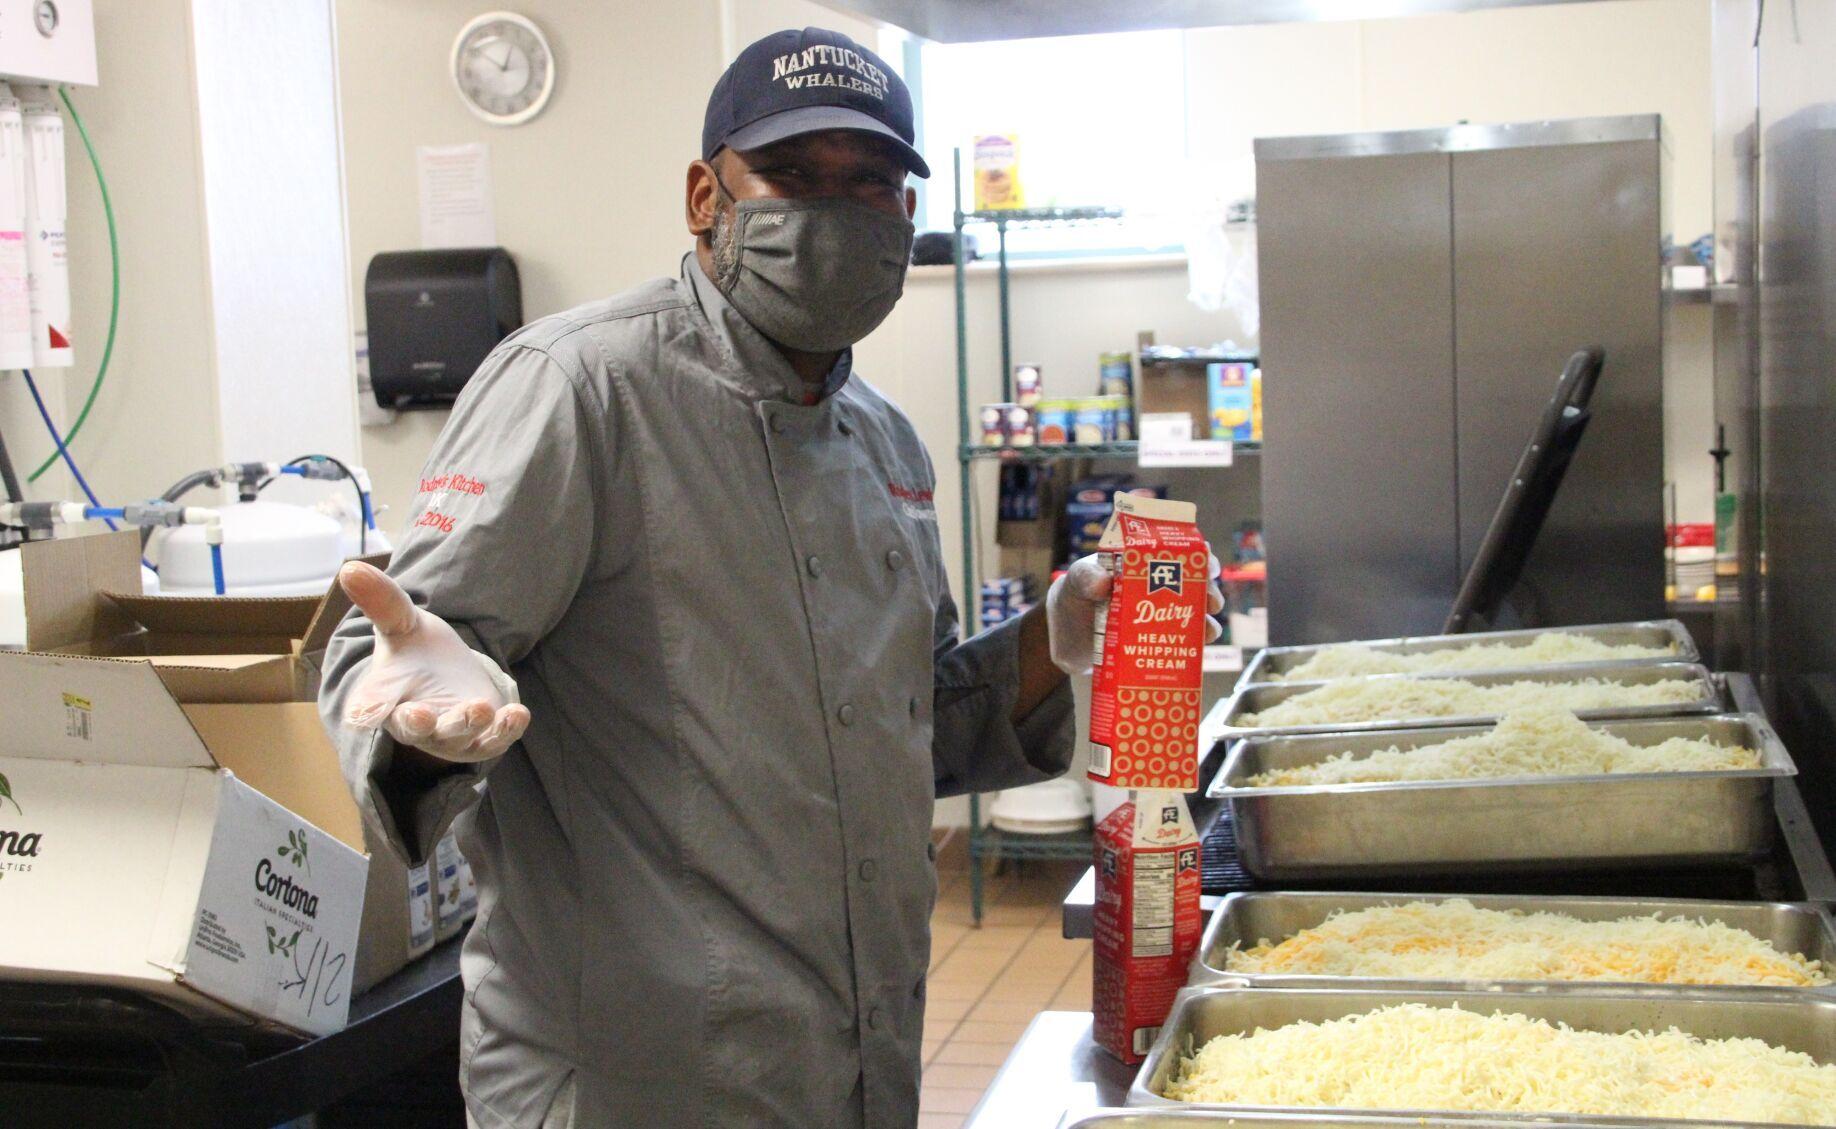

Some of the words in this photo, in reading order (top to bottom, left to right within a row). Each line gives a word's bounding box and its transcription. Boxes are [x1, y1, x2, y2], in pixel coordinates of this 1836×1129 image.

[772, 44, 889, 93] NANTUCKET
[785, 72, 884, 100] WHALERS
[448, 474, 486, 496] Kitchen
[420, 511, 457, 533] 2016
[1125, 535, 1158, 549] Dairy
[1133, 600, 1195, 628] Dairy
[1137, 633, 1187, 645] HEAVY
[1123, 645, 1198, 657] WHIPPING
[1135, 658, 1187, 669] CREAM
[255, 858, 319, 919] Cortona
